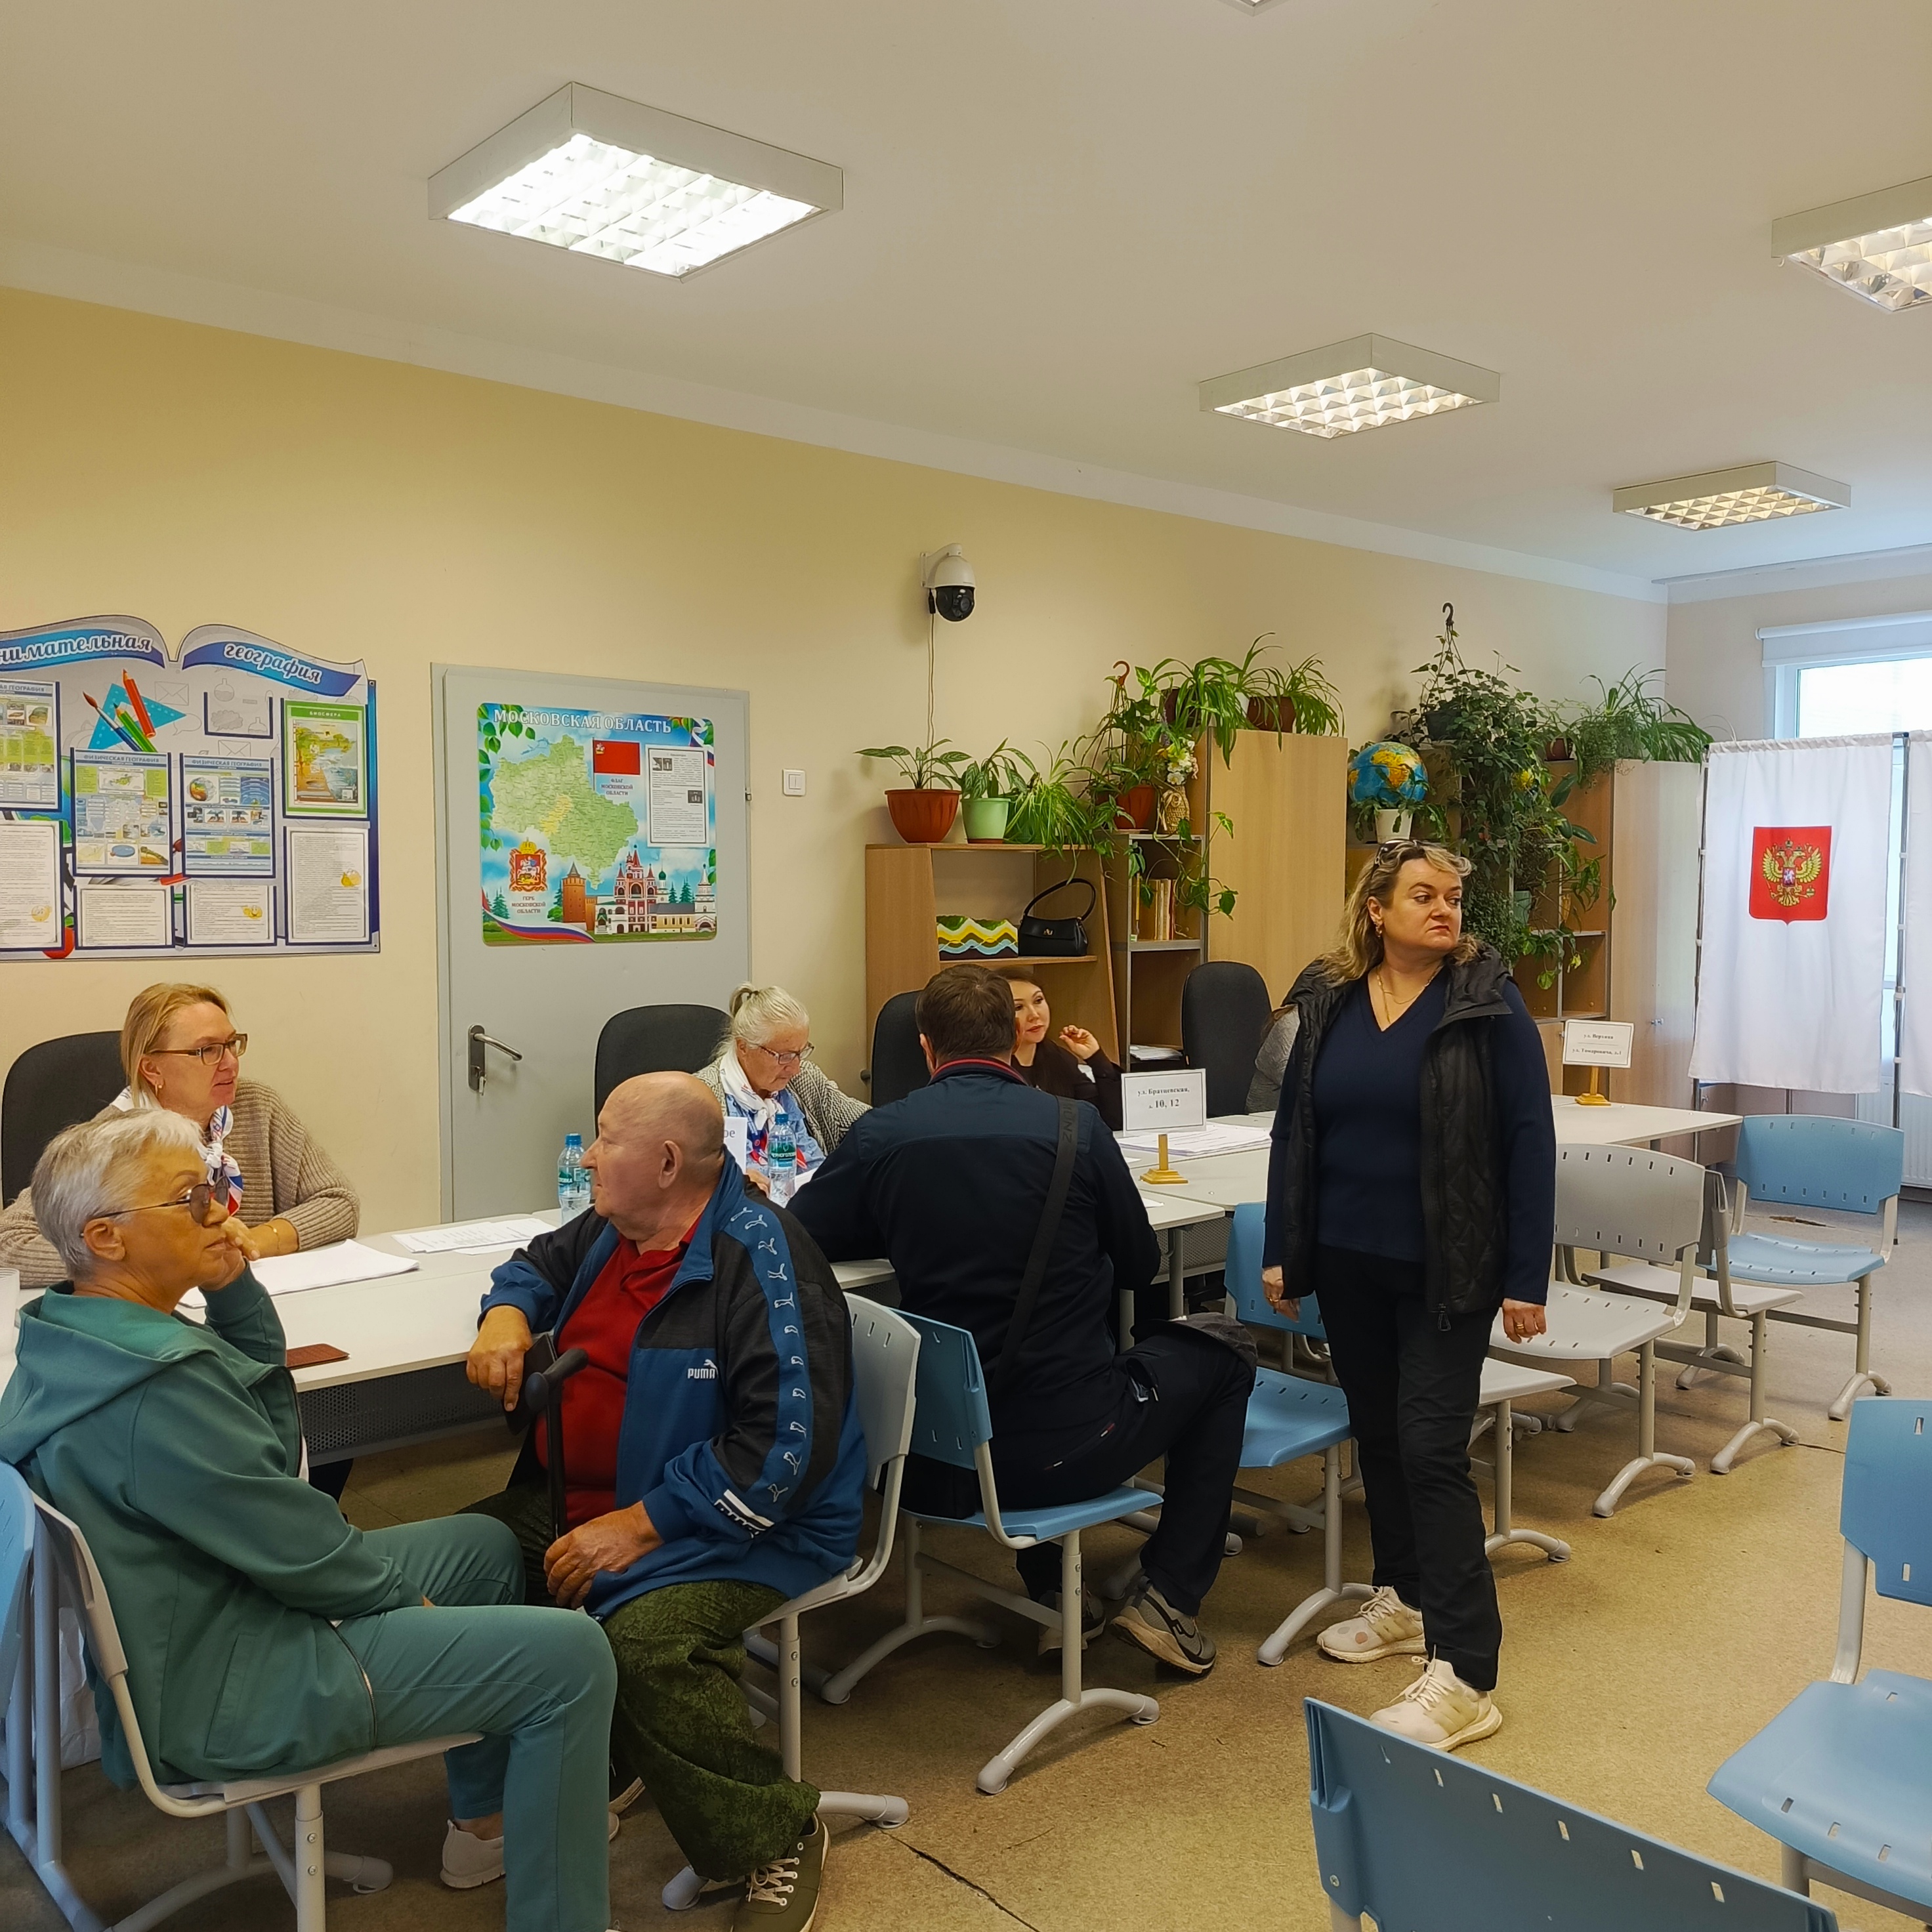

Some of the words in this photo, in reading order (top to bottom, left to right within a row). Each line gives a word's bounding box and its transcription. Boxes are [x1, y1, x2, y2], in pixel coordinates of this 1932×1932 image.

[224, 644, 321, 683] география
[494, 709, 600, 729] МОСКОВСКАЯ
[604, 716, 671, 734] ОБЛАСТЬ
[1148, 1087, 1190, 1096] Братцевская,
[1155, 1099, 1167, 1109] 10,
[1170, 1099, 1180, 1107] 12
[687, 1368, 715, 1379] PUMA
